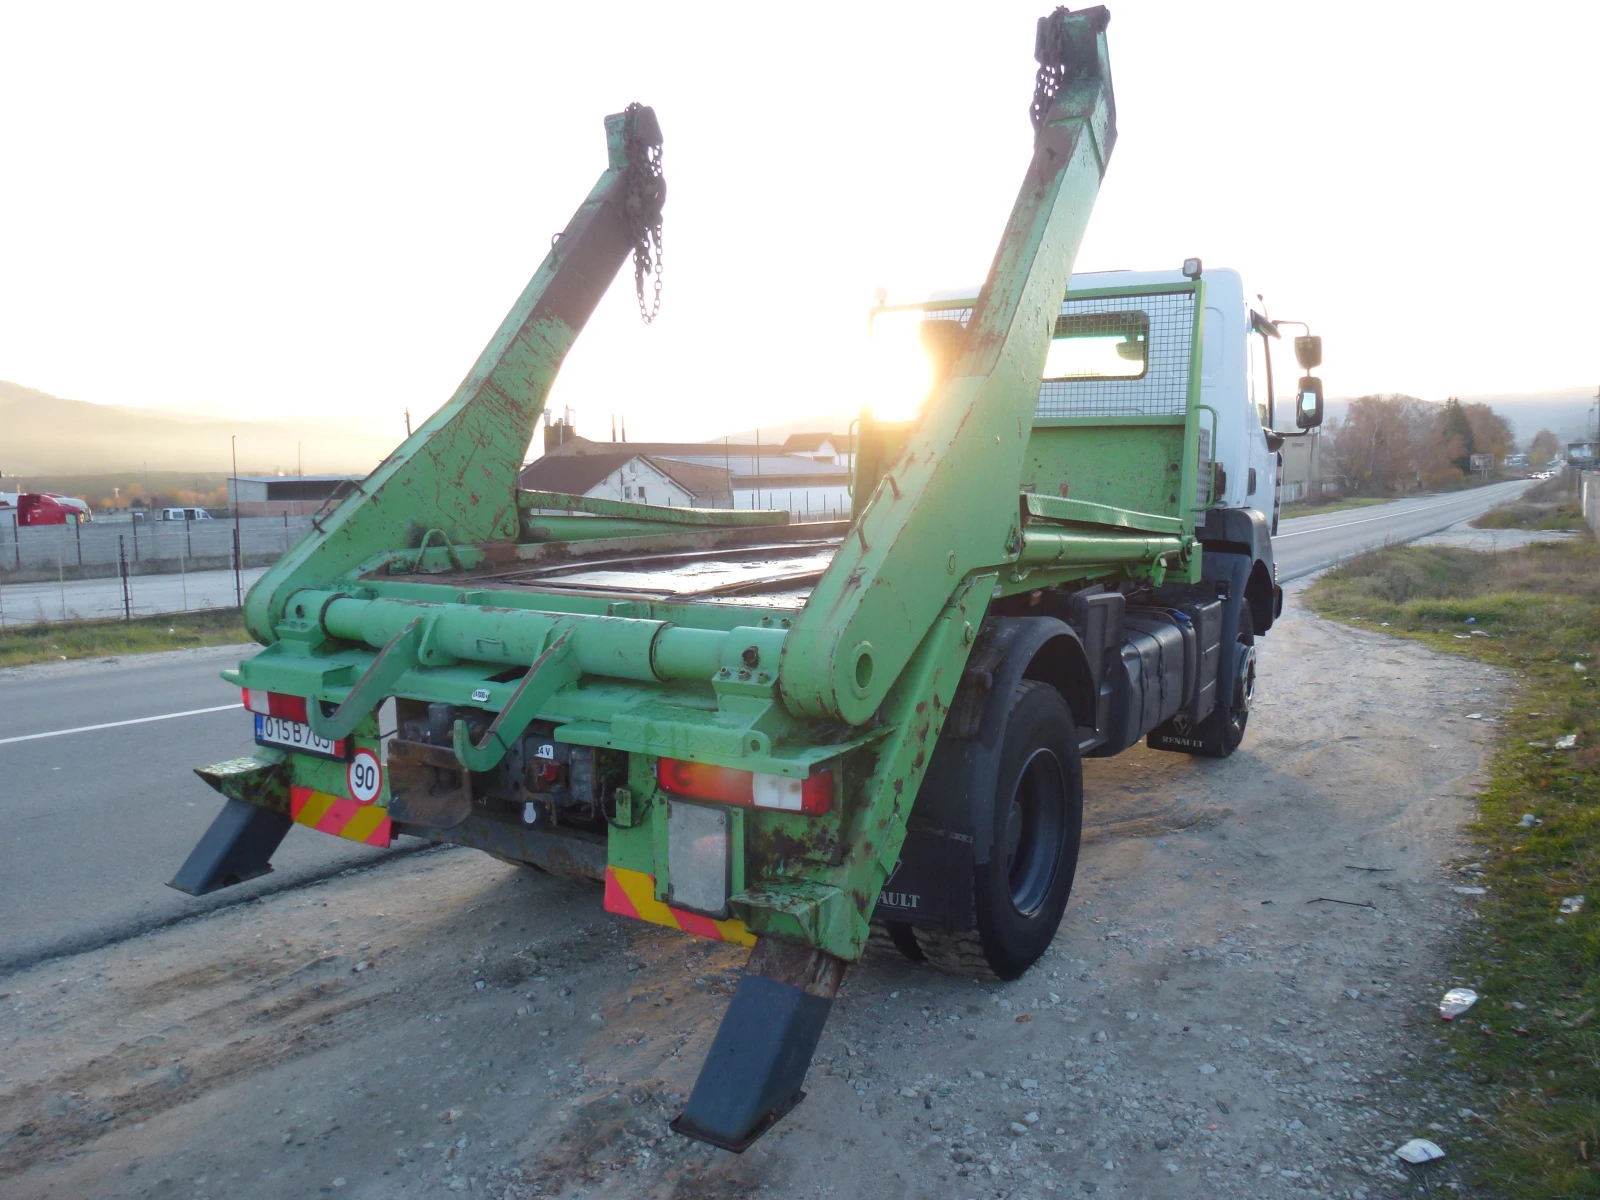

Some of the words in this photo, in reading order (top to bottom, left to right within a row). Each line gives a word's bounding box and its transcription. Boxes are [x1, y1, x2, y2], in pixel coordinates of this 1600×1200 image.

[1162, 735, 1204, 748] RENAULT
[355, 763, 375, 791] 90
[877, 890, 920, 908] AULT
